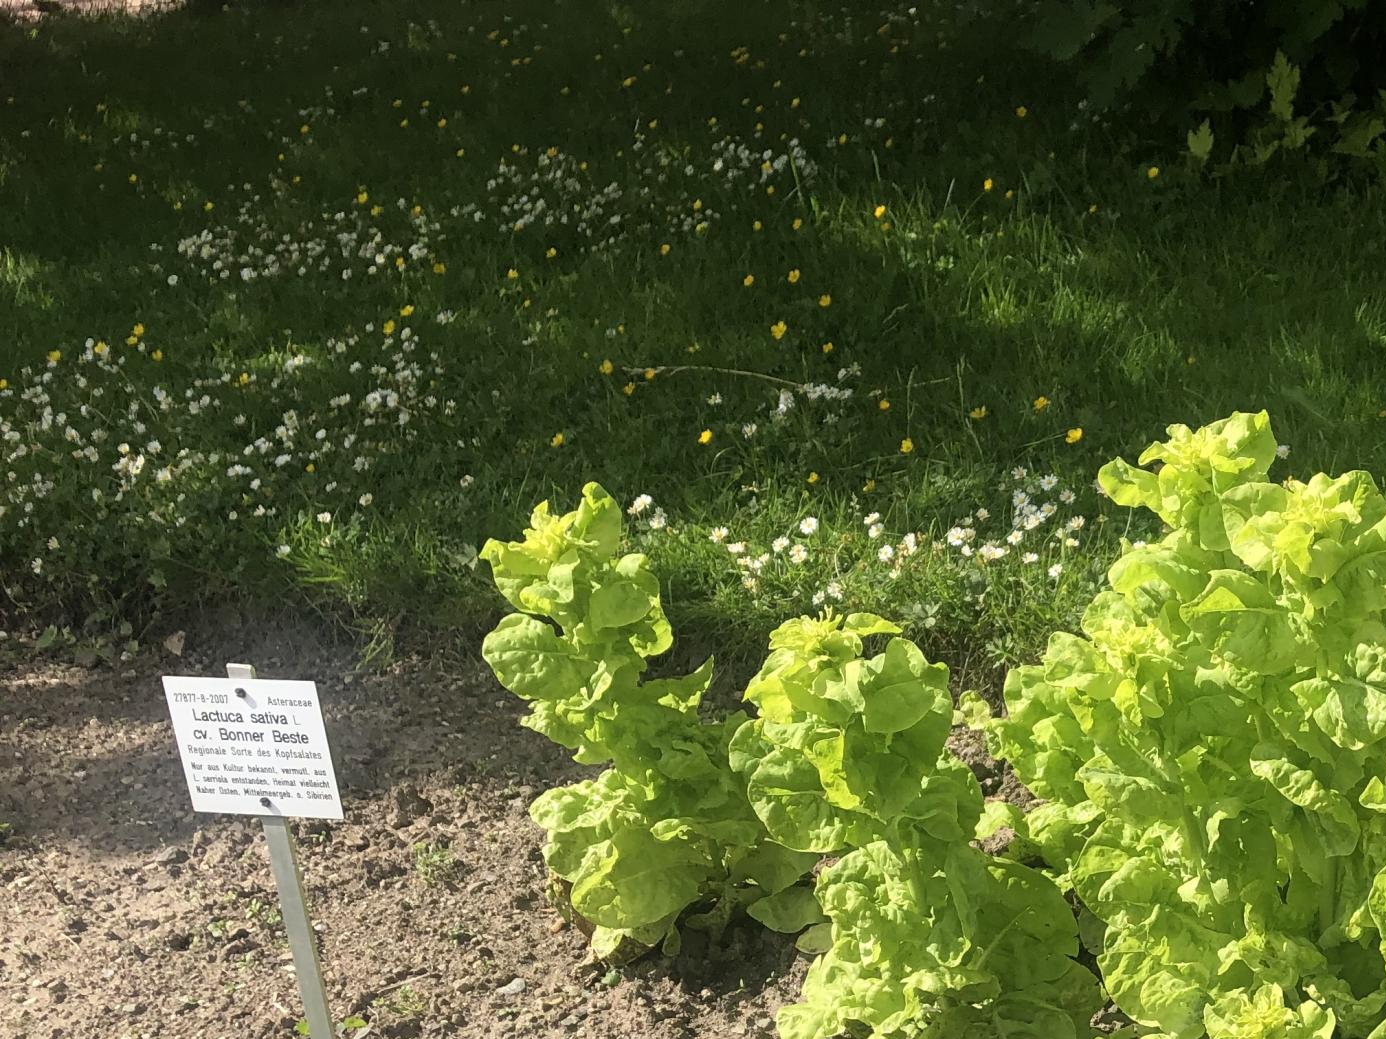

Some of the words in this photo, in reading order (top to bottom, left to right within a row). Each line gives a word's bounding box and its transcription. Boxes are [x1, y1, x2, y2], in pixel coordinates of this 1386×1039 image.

[267, 696, 312, 707] Asteraceae
[192, 708, 244, 723] Lactuca
[250, 712, 288, 725] sativa
[193, 729, 212, 740] cv.
[219, 728, 265, 742] Bonner
[272, 730, 309, 744] Beste
[188, 745, 226, 756] Regionale
[231, 746, 252, 757] Sorte
[257, 748, 271, 757] des
[275, 748, 322, 760] Kopfsalates
[223, 763, 244, 773] Kultur
[273, 777, 296, 787] Heimat
[300, 779, 330, 789] vielleicht
[196, 785, 215, 794] Naher
[306, 791, 333, 800] Sibirien
